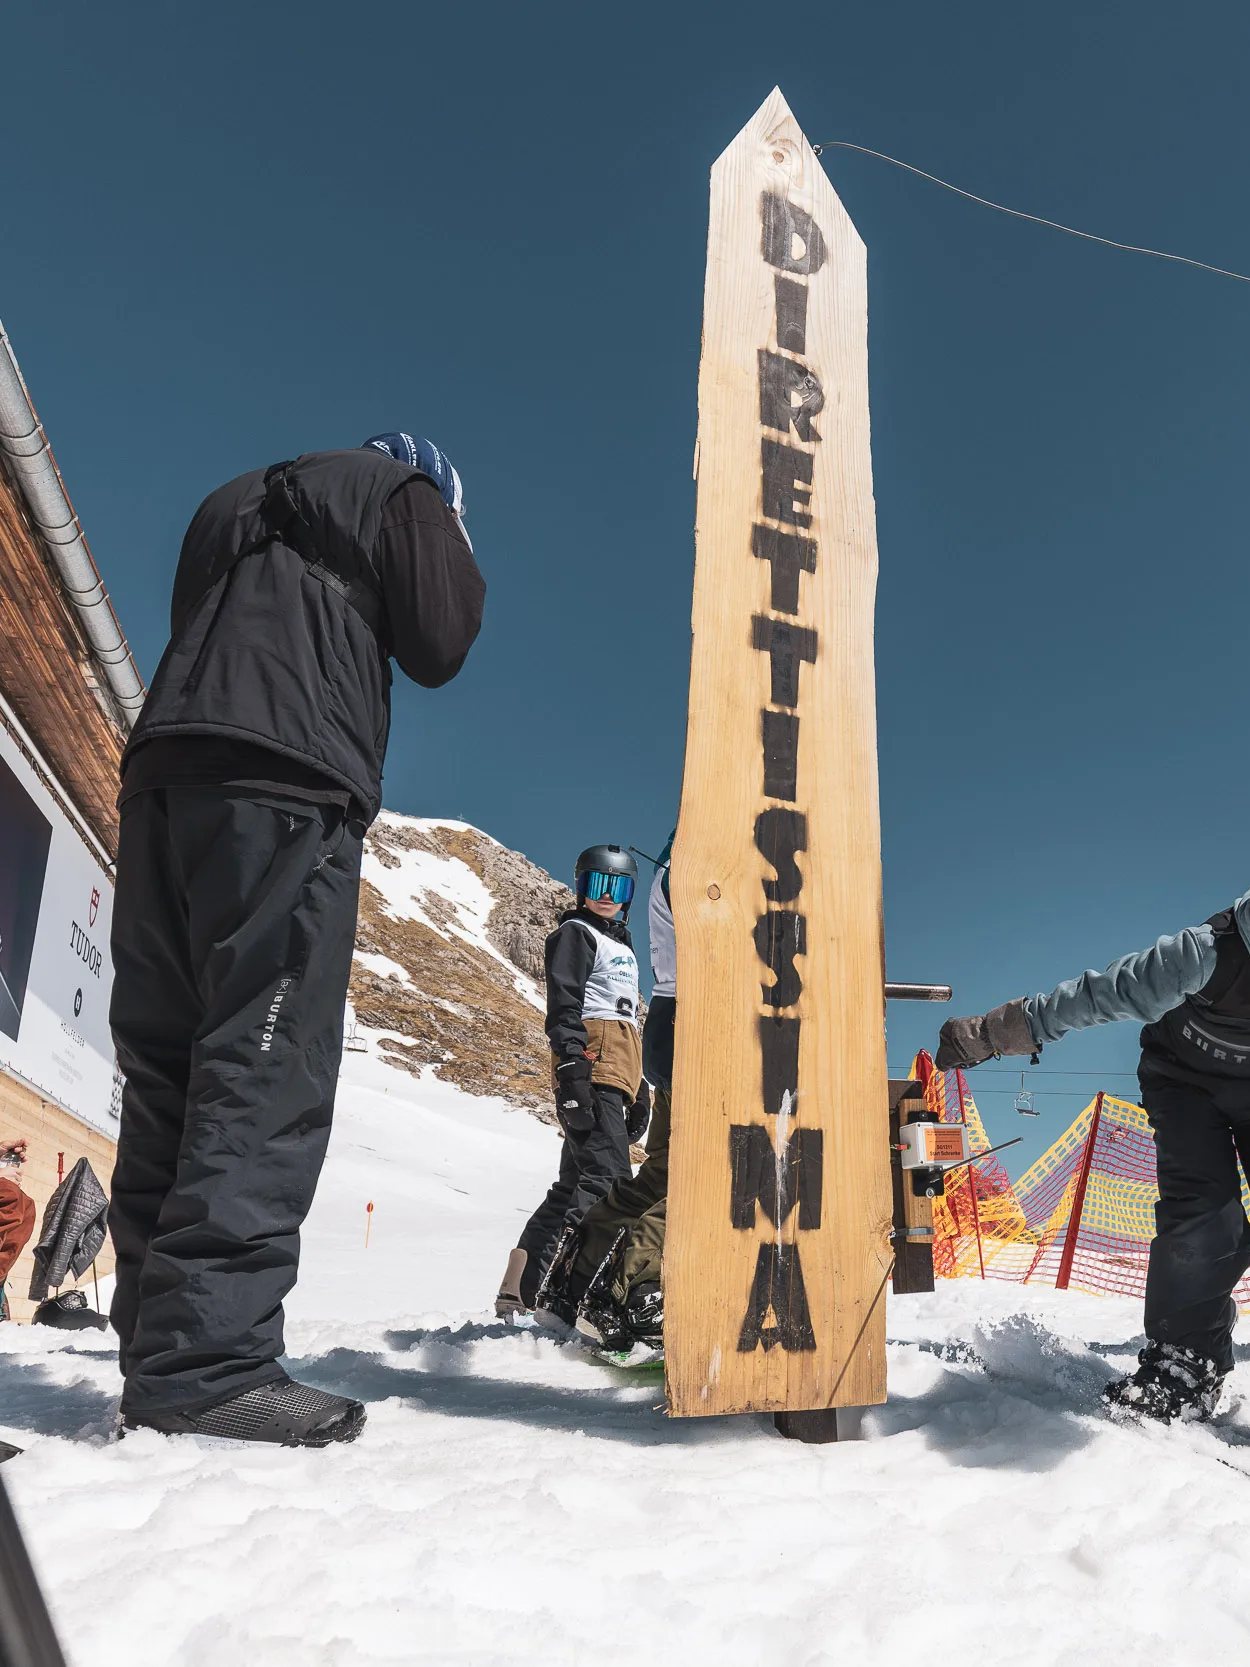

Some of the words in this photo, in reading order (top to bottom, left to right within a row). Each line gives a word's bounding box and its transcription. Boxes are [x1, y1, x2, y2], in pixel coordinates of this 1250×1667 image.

[727, 189, 827, 1354] DIRETTISSIMA
[70, 920, 102, 979] TUDOR
[260, 996, 283, 1051] BURTON
